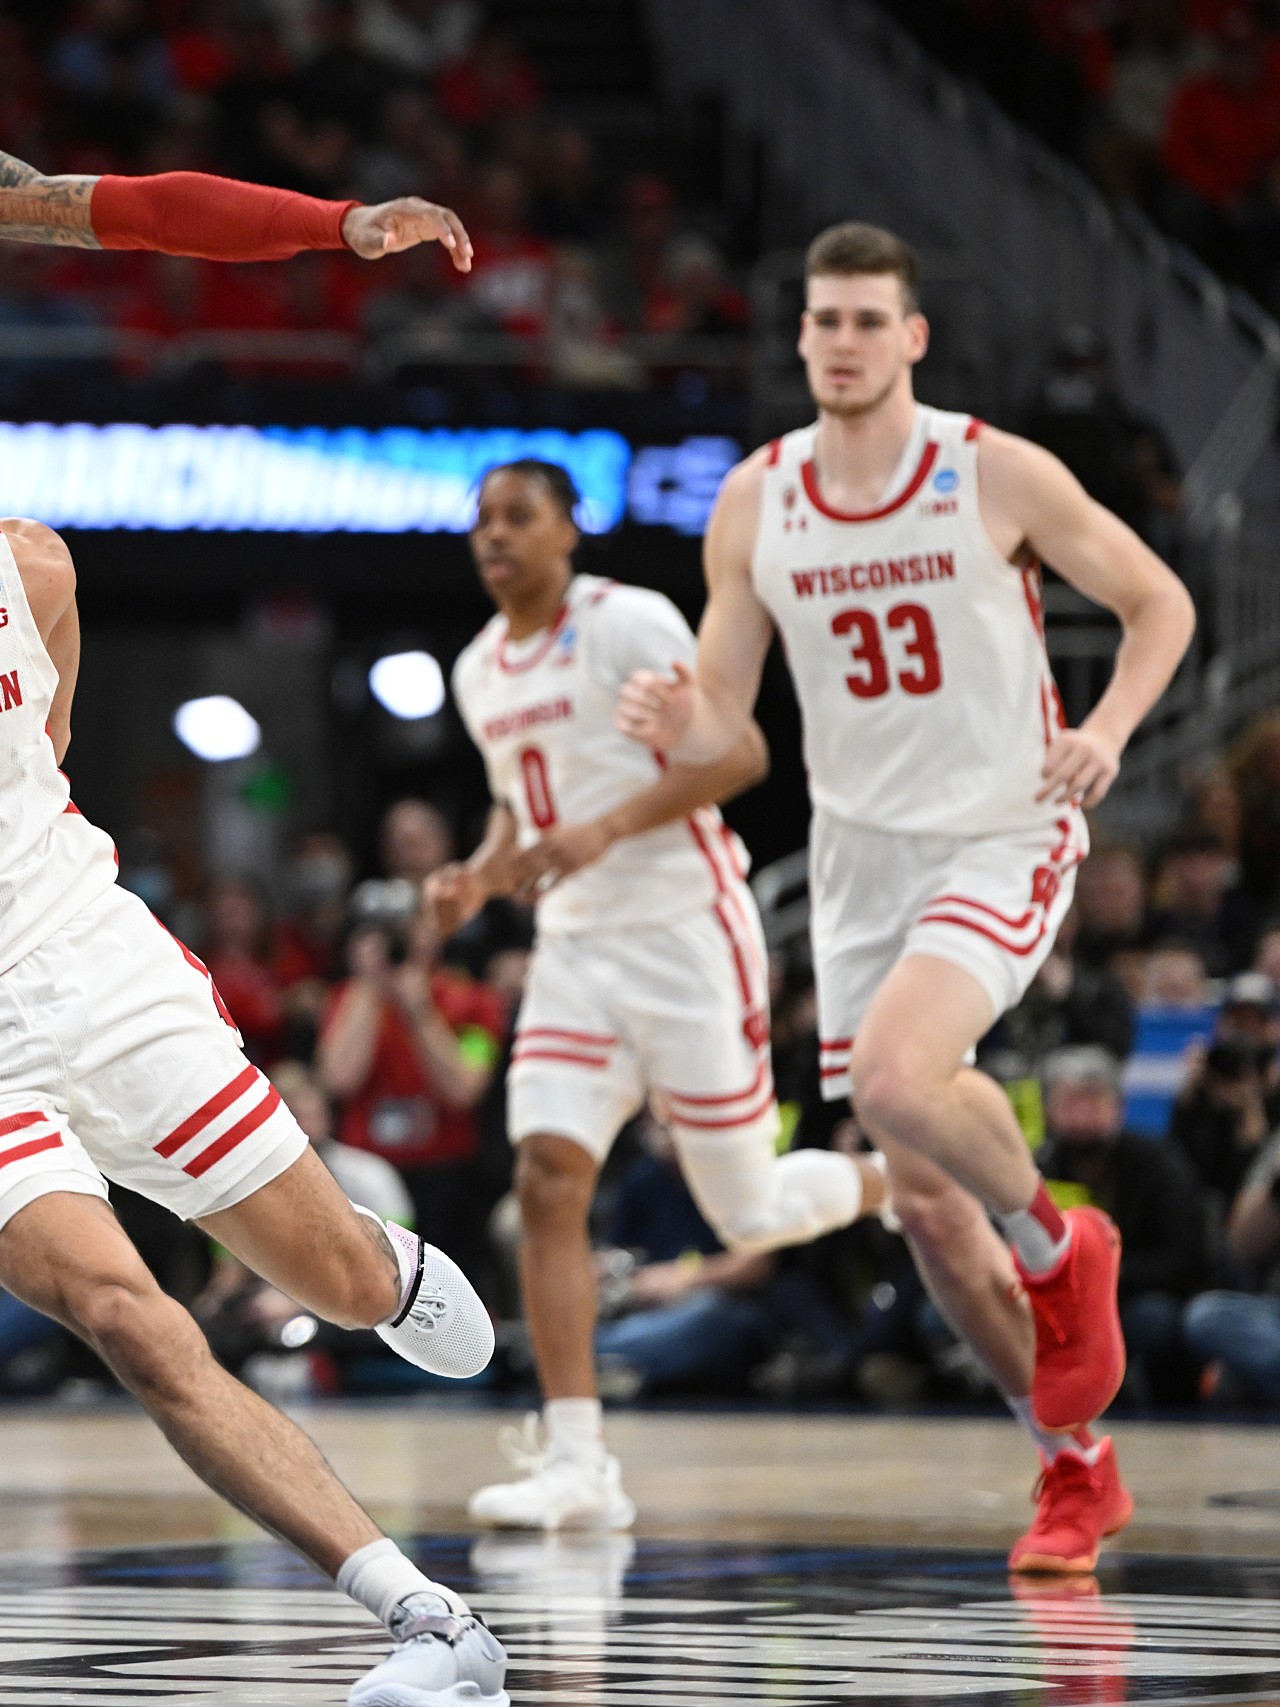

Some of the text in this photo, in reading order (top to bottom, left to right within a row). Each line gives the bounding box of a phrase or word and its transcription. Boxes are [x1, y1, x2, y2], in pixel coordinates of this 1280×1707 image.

[792, 550, 956, 599] WISCONSIN
[831, 602, 943, 698] 33
[522, 744, 557, 830] 0
